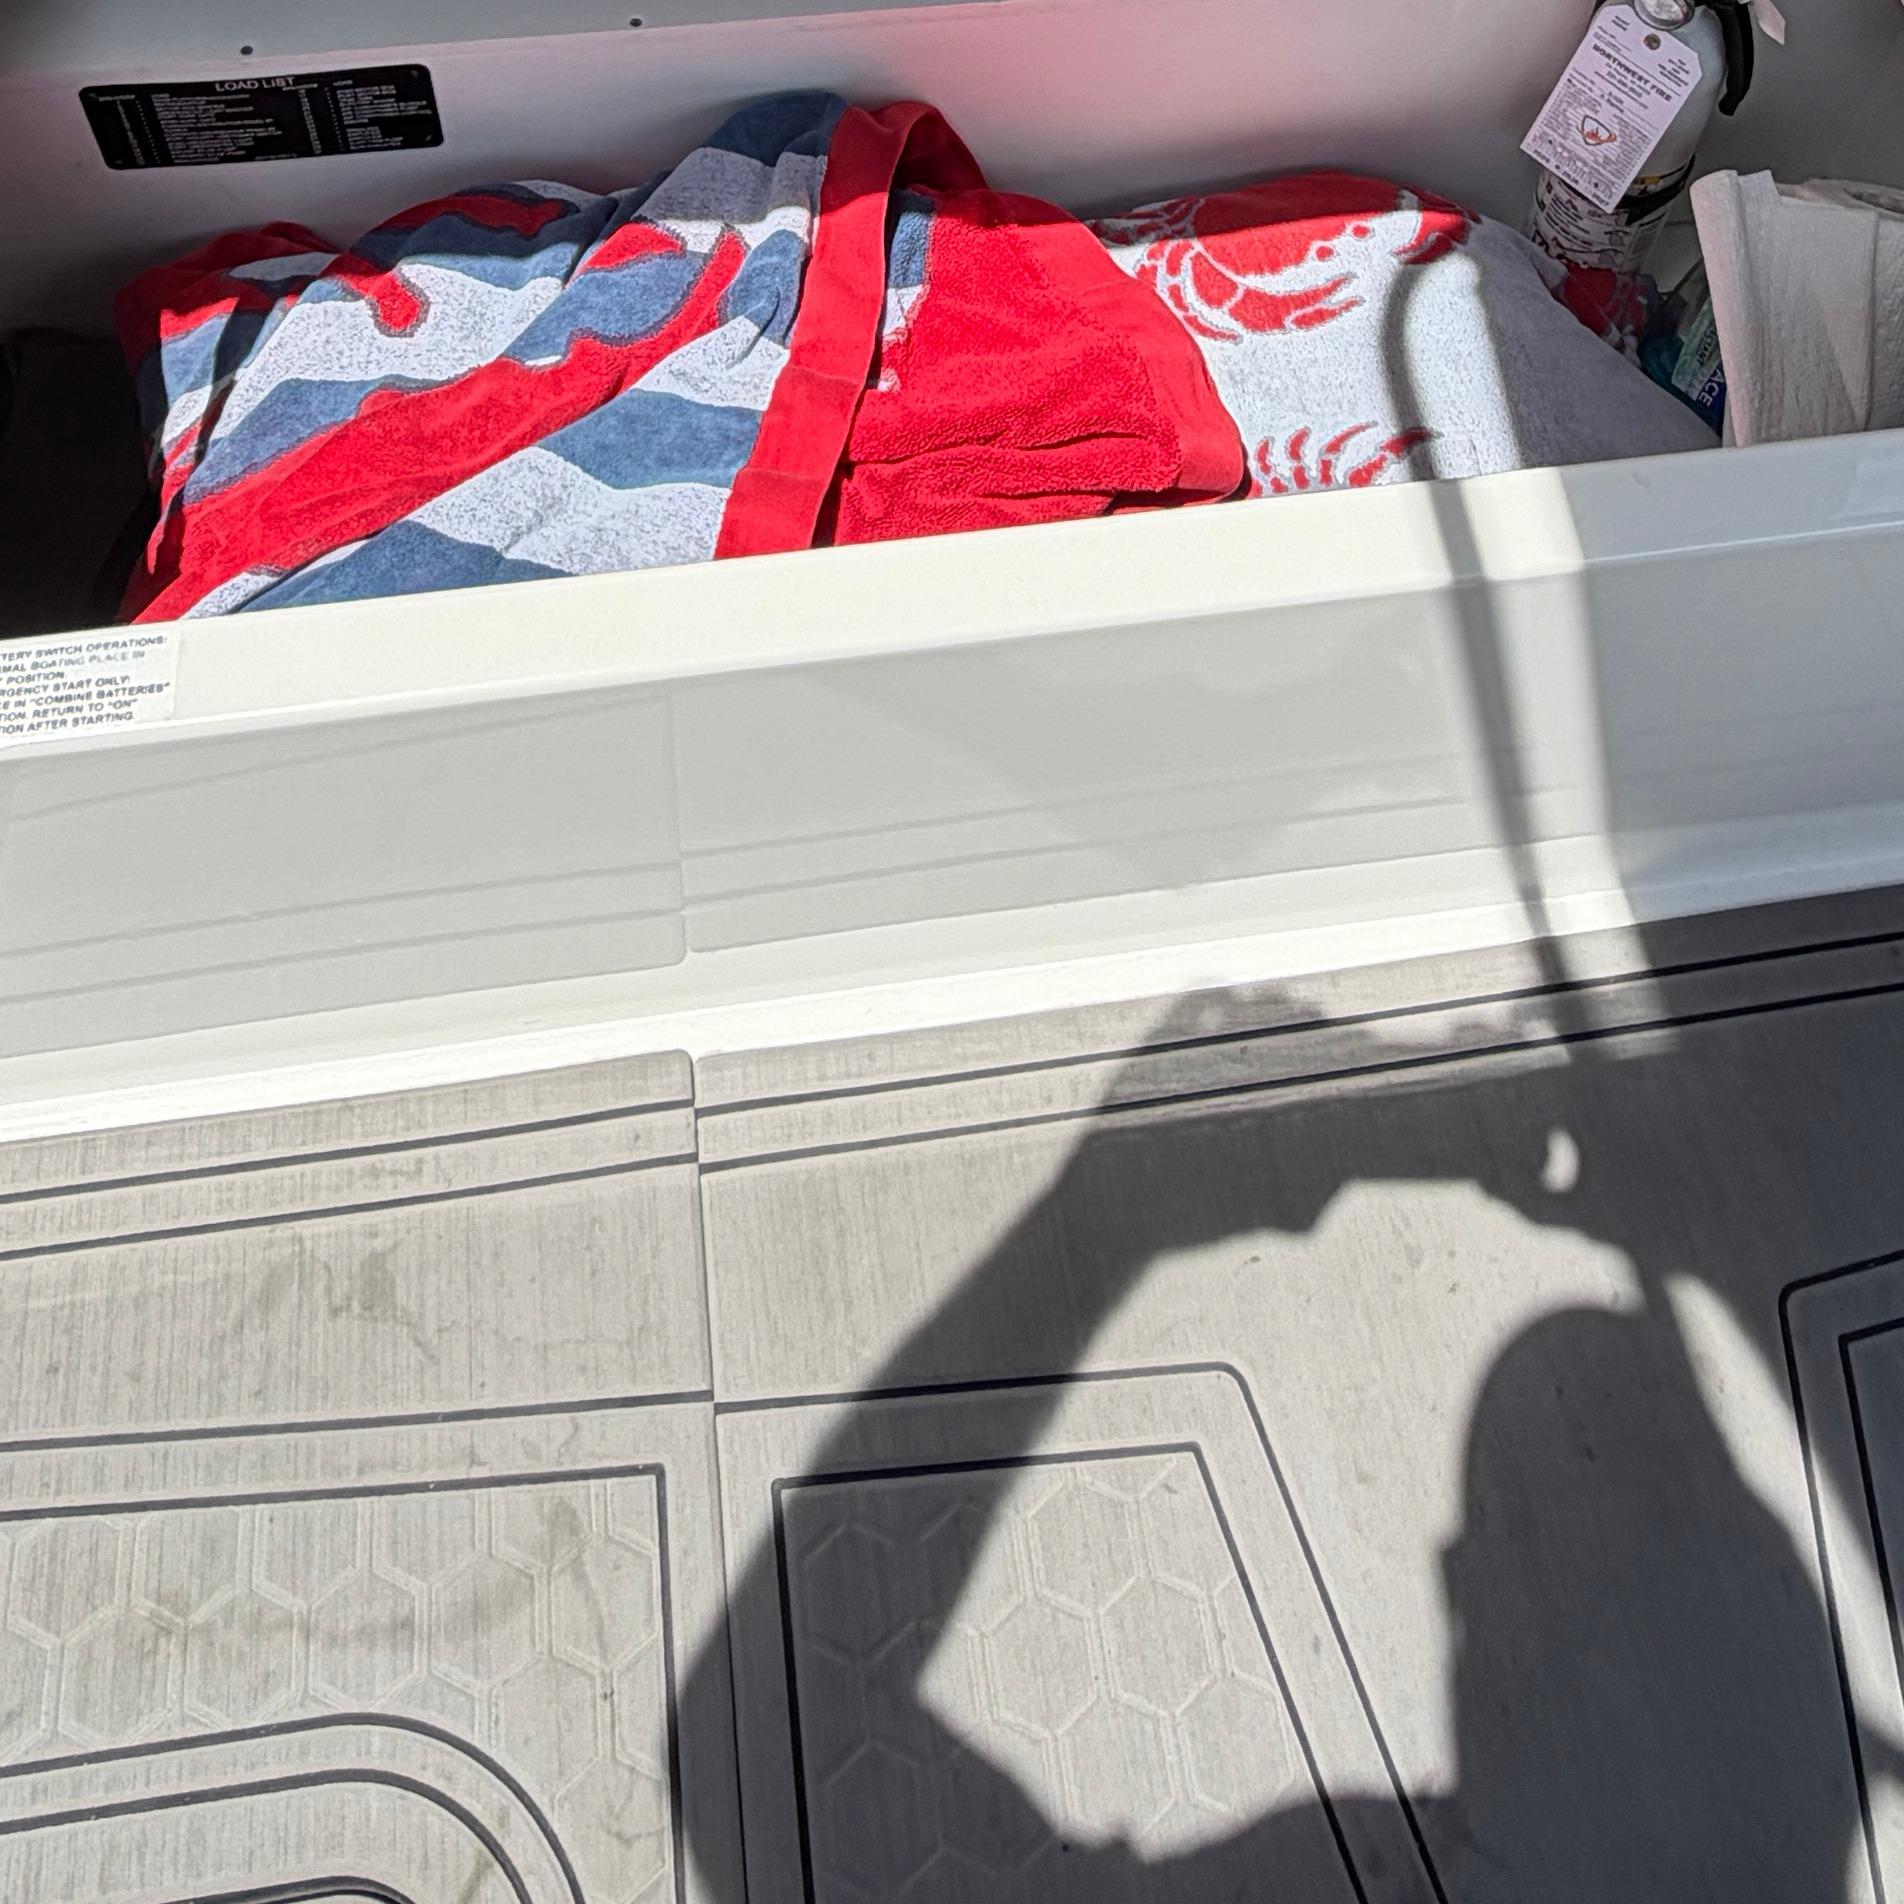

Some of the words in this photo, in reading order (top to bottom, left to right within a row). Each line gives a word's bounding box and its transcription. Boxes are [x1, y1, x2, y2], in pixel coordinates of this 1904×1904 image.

[215, 78, 259, 92] LOAD
[262, 76, 295, 89] LIST
[30, 656, 86, 671] BOATING
[88, 652, 129, 664] PLACE
[133, 649, 146, 659] IN
[35, 645, 83, 659] SWITCH
[53, 678, 92, 692] START
[13, 698, 26, 708] IN
[30, 691, 93, 707] "COMBINE
[96, 682, 171, 699] BATTERIES"
[32, 704, 84, 719] RETURN
[88, 701, 104, 712] TO
[107, 698, 138, 710] "ON"
[27, 718, 68, 732] AFTER
